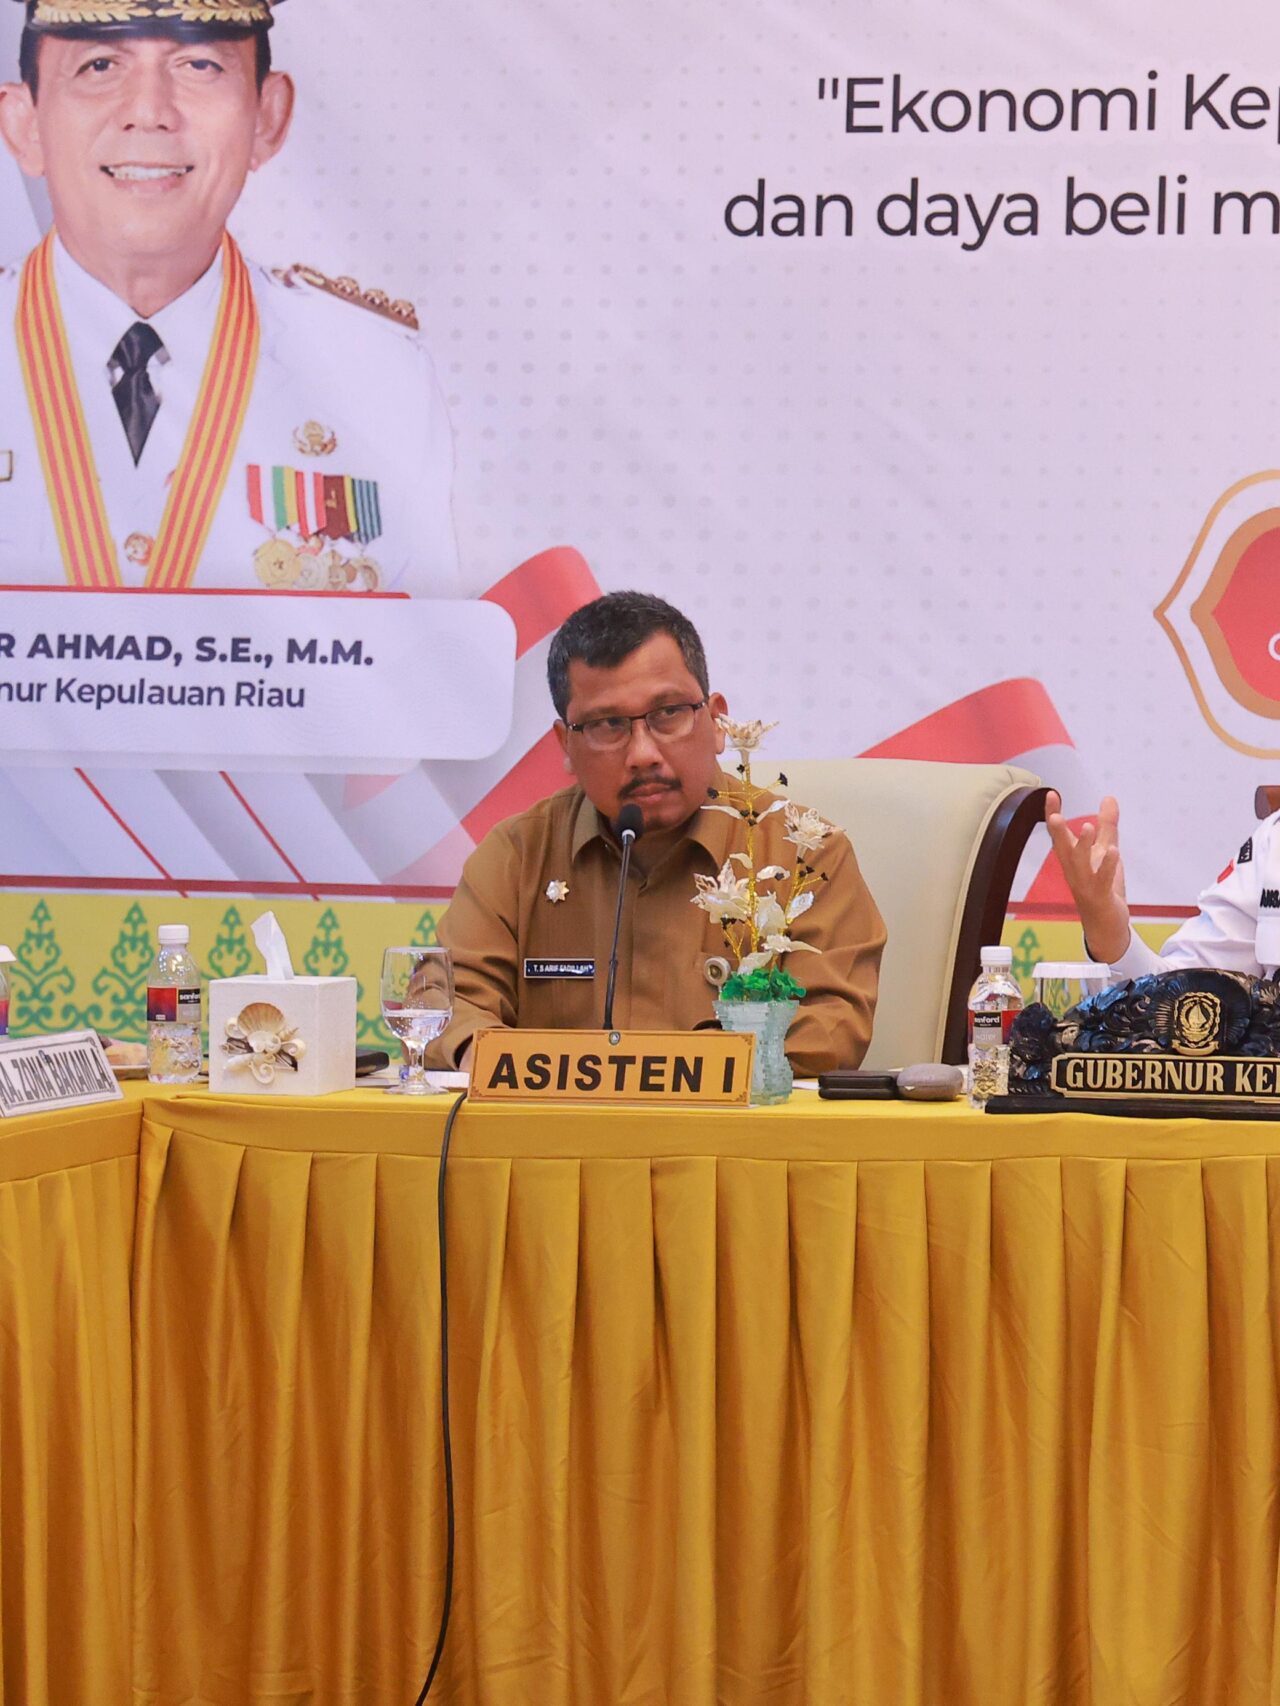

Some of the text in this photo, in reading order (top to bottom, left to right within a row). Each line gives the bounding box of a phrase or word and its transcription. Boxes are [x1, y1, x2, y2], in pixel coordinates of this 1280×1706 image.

[816, 69, 1158, 134] "Ekonomi
[724, 178, 854, 238] dan
[876, 177, 1039, 252] daya
[1065, 174, 1188, 236] beli
[26, 633, 182, 667] AHMAD,
[195, 637, 273, 668] S.E.,
[286, 638, 374, 666] M.M.
[55, 677, 226, 710] Kepulauan
[234, 679, 305, 708] Riau
[10, 1055, 58, 1100] ZONA
[44, 1047, 115, 1096] BAKAMLA
[487, 1053, 736, 1093] ASISTEN I
[1066, 1059, 1225, 1092] GUBERNUR
